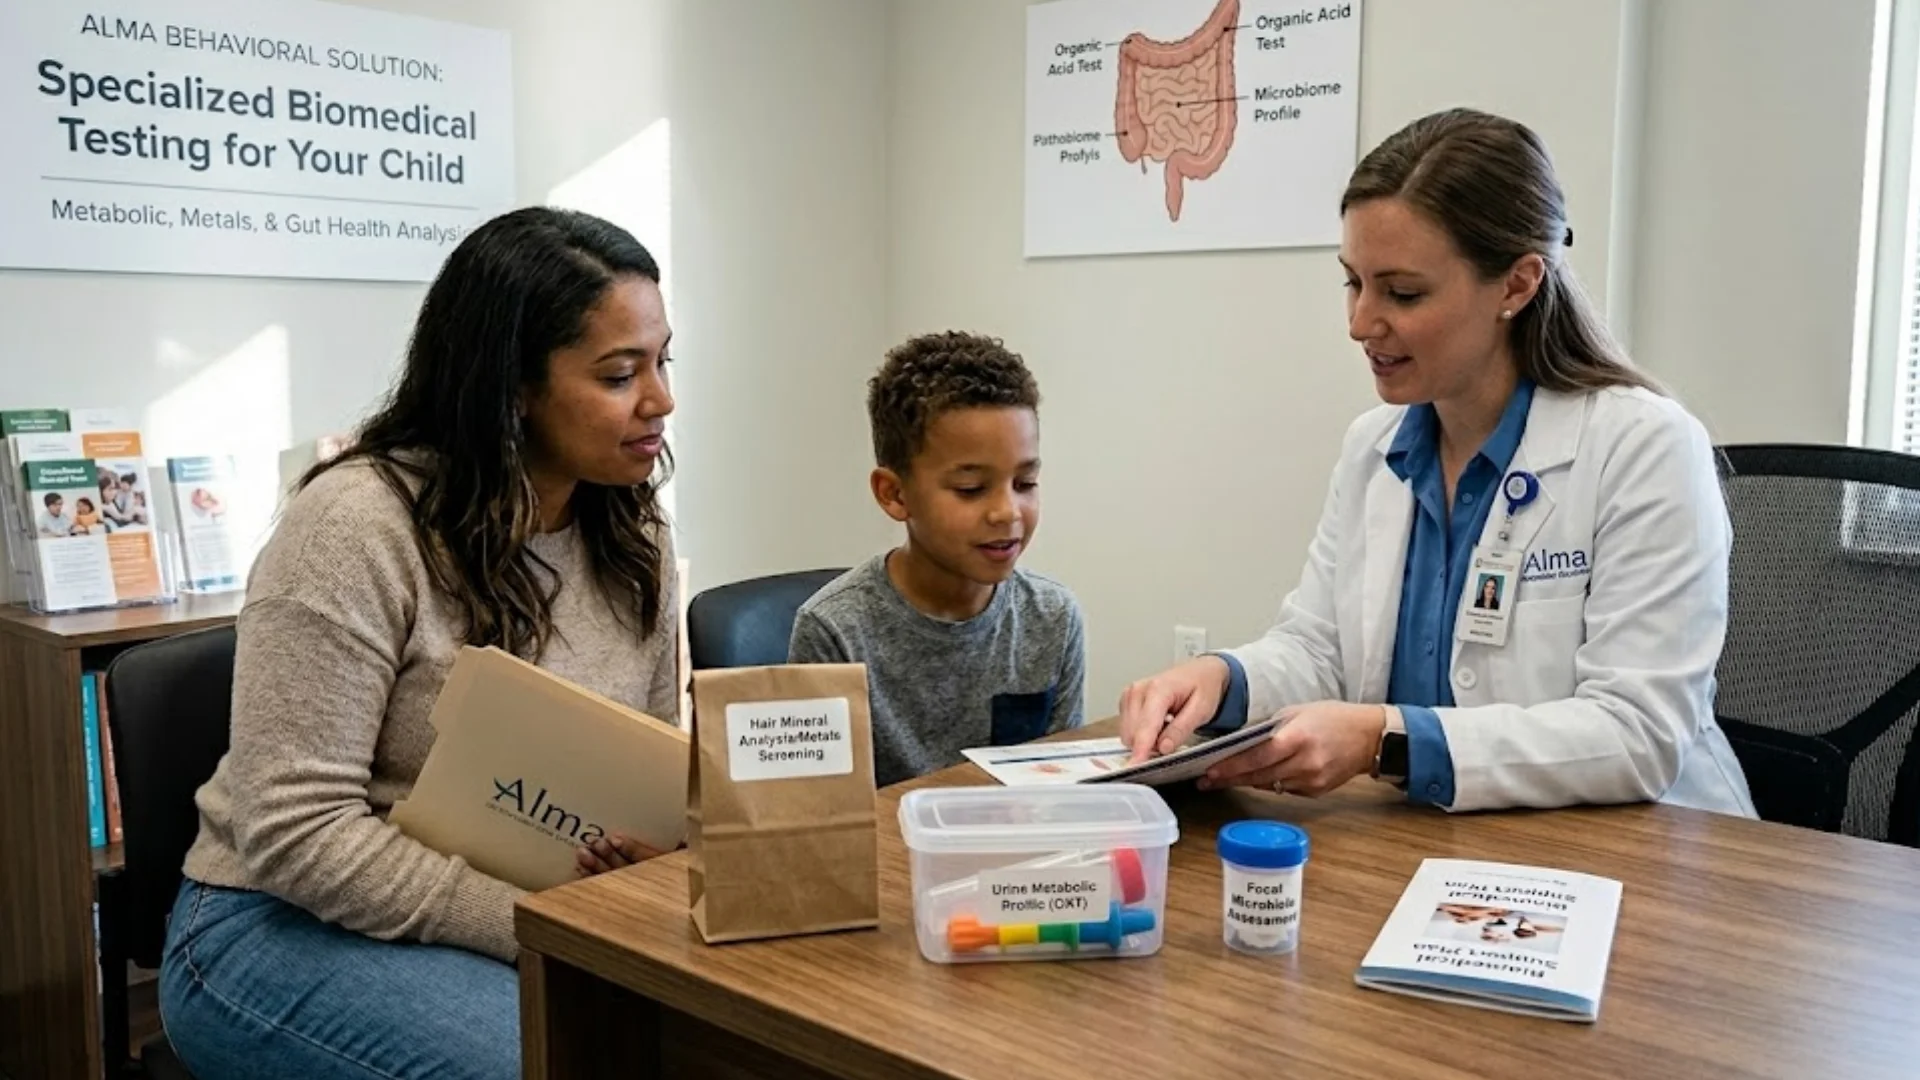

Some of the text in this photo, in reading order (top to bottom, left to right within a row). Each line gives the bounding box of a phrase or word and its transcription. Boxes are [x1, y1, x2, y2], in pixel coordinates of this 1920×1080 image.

[1256, 4, 1351, 32] Organic Acid
[80, 13, 443, 82] ALMA BEHAVIORAL SOLUTION:
[1054, 40, 1102, 58] Organic
[1256, 36, 1286, 51] Test
[1047, 59, 1102, 77] Acid Test
[38, 59, 477, 140] Specialized Biomedical
[1254, 80, 1341, 102] Microbiome
[1254, 107, 1301, 123] Profile
[59, 116, 464, 184] Testing for Your Child
[51, 199, 174, 228] Metabolic,
[180, 208, 258, 233] Metals,
[264, 214, 278, 232] &
[286, 213, 321, 236] Gut
[328, 217, 390, 239] Health
[1524, 548, 1588, 573] Alma
[750, 714, 828, 730] Hair Mineral
[992, 880, 1097, 896] Urine Metabolic
